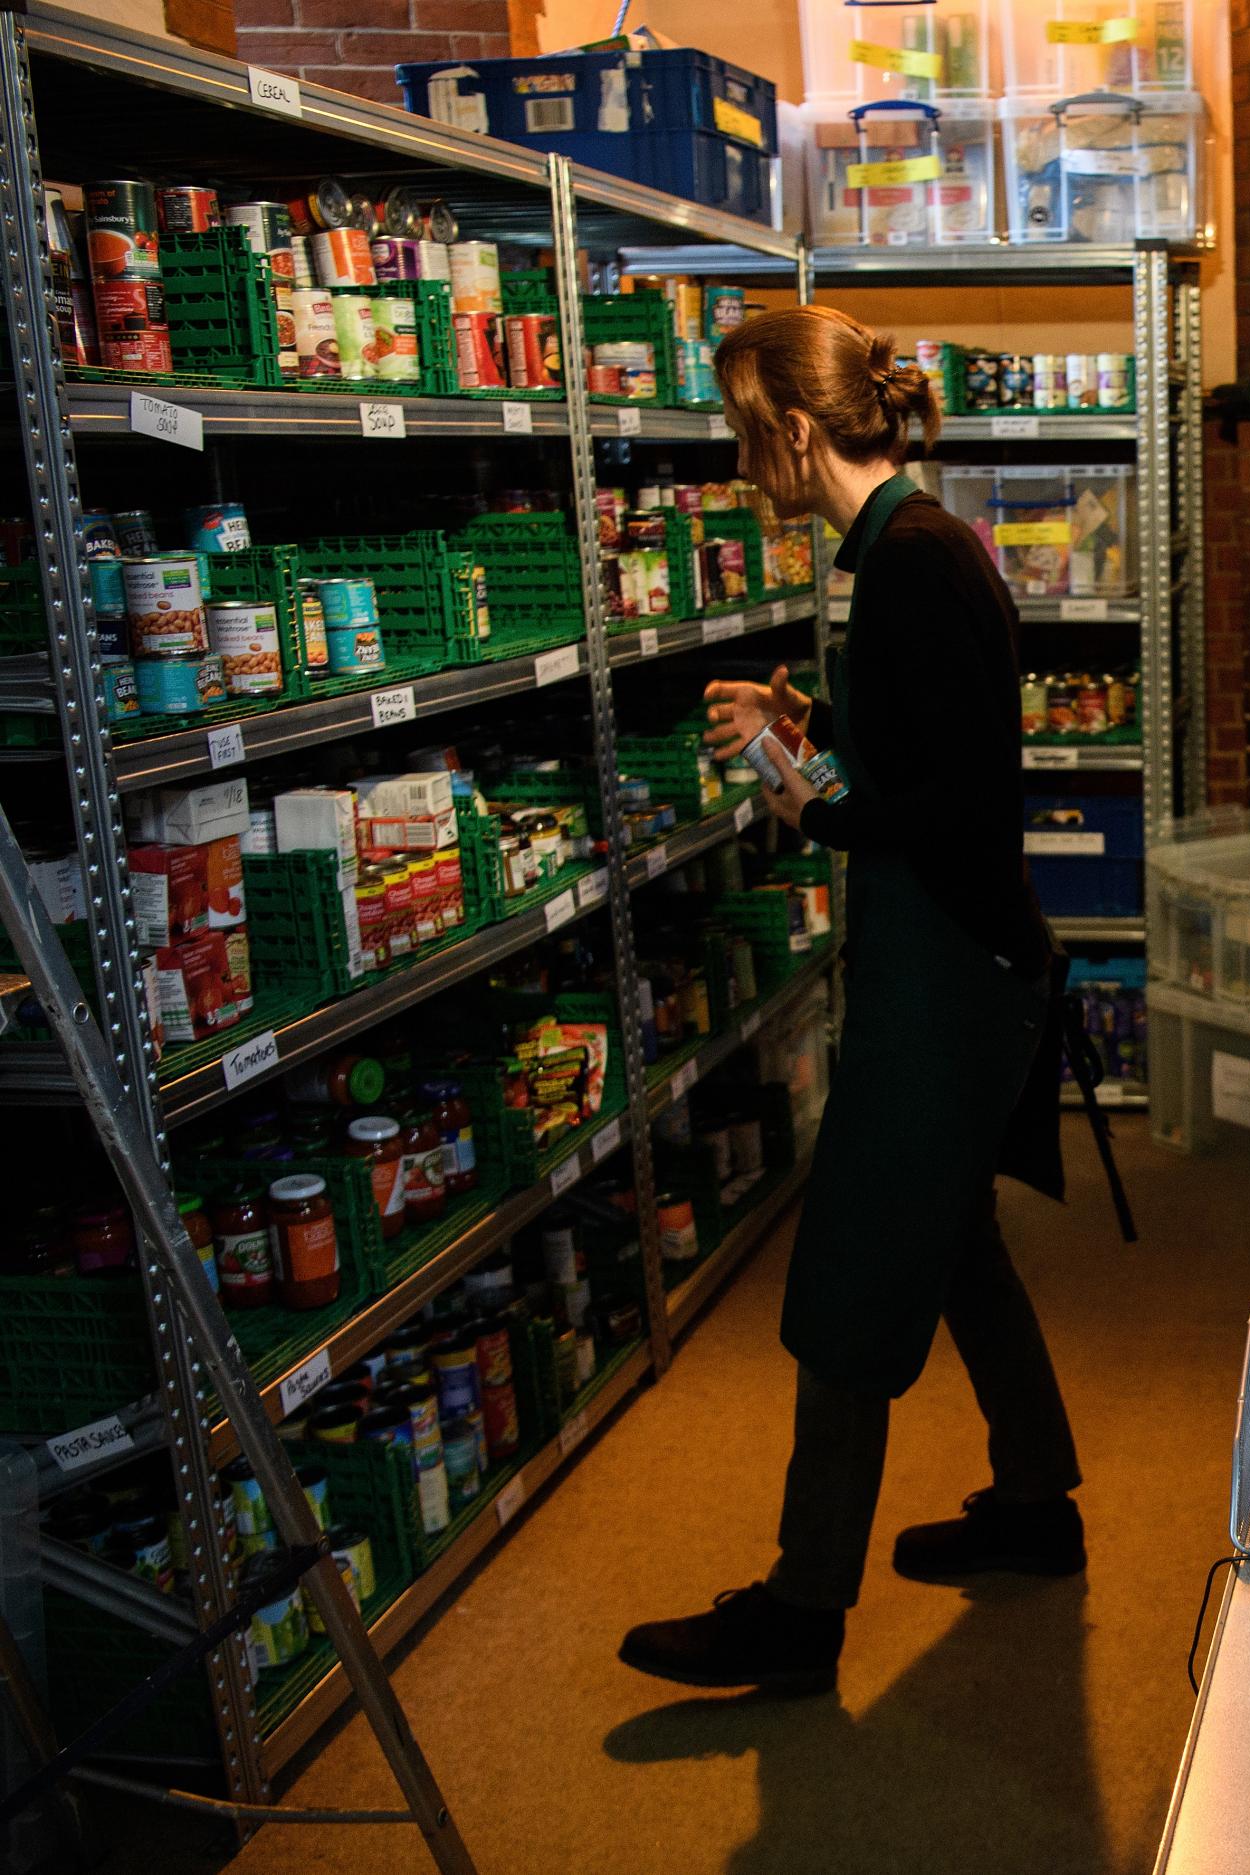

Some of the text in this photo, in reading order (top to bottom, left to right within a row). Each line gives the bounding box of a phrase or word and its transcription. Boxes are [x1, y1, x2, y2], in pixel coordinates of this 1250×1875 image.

[257, 80, 290, 102] CEREAL
[380, 709, 406, 722] BEANS
[230, 1040, 276, 1076] Tomatoes
[54, 1437, 91, 1462] PASTA
